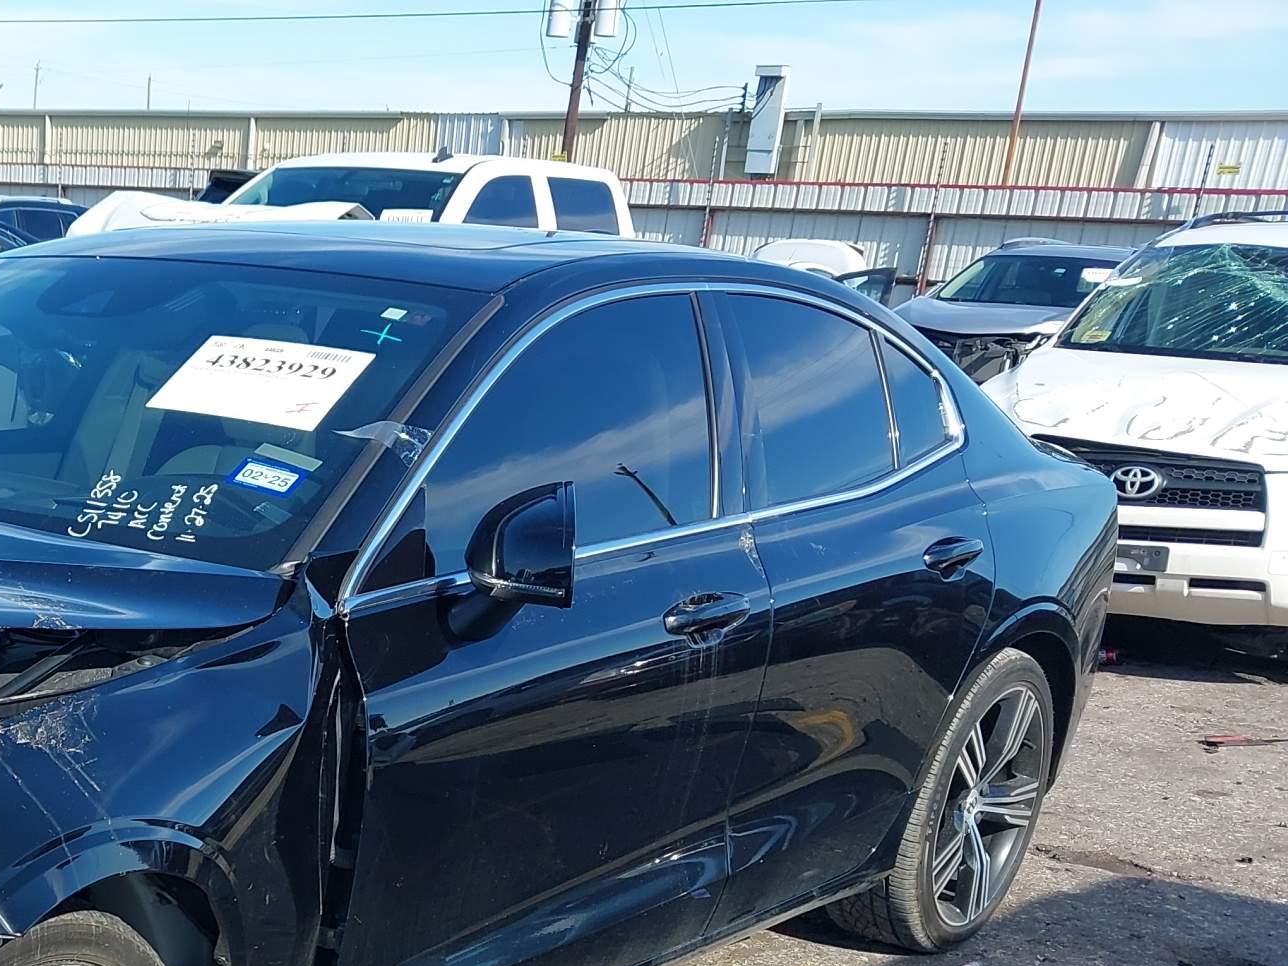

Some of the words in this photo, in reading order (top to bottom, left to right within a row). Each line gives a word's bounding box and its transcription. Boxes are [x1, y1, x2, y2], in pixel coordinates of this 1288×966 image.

[205, 352, 338, 381] 43823929
[241, 468, 264, 481] 02
[267, 475, 291, 488] 25
